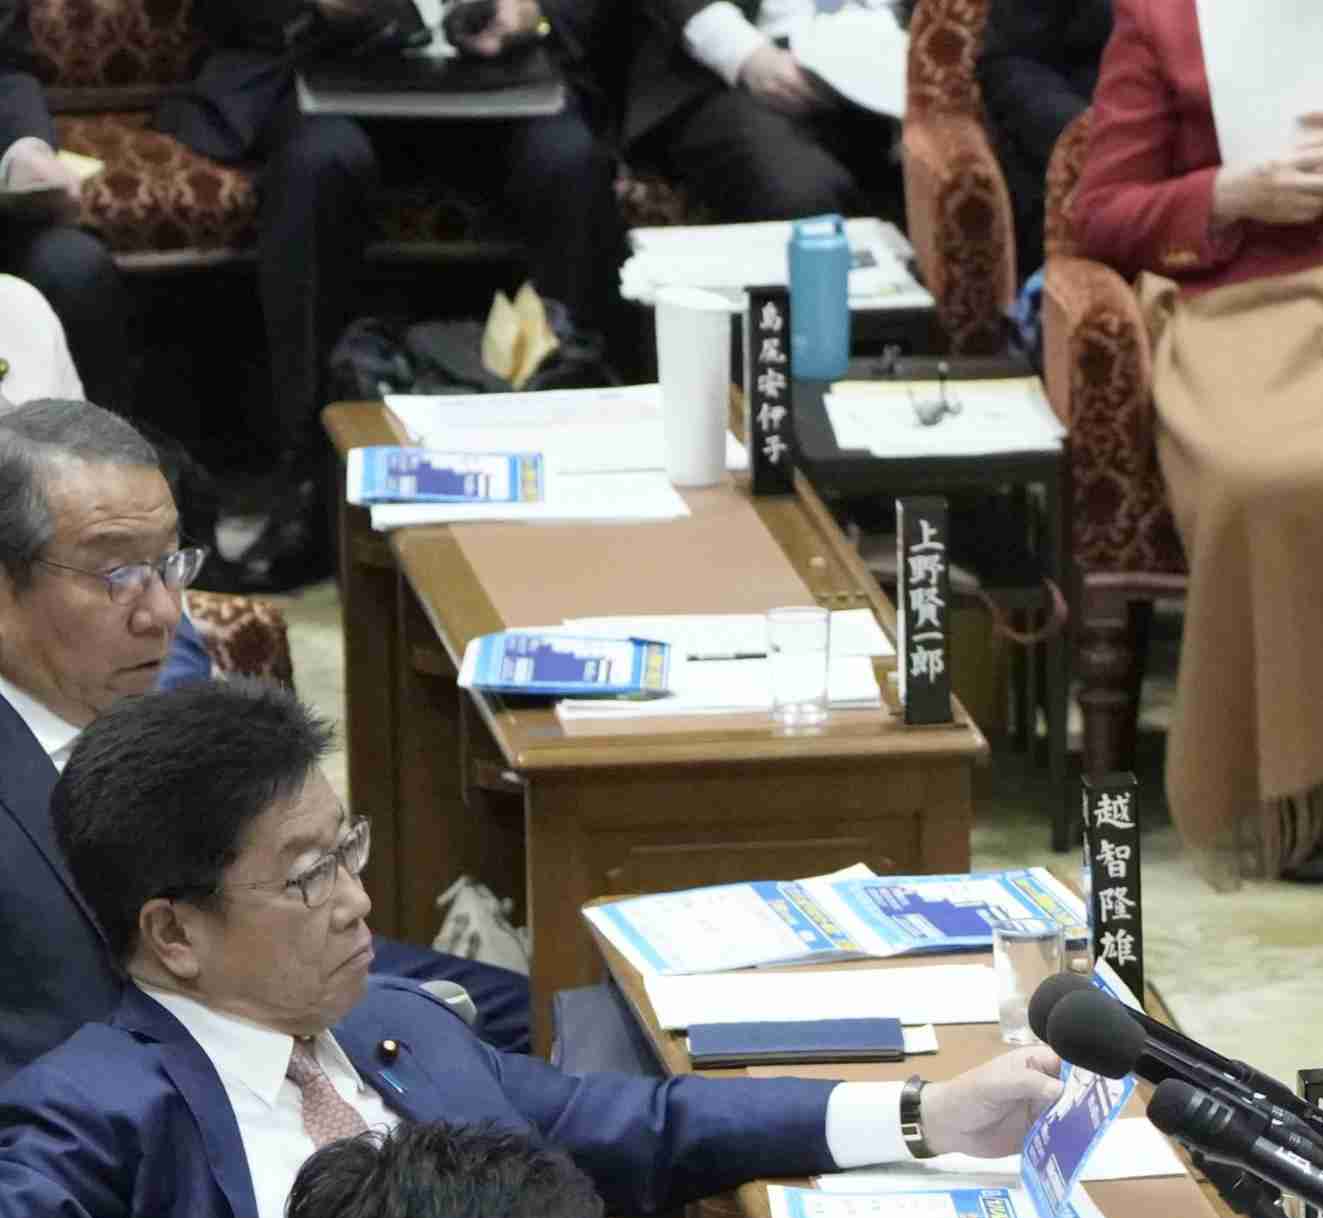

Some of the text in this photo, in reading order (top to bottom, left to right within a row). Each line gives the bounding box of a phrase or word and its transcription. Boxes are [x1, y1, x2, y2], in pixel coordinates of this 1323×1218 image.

[907, 519, 945, 684] 上野賢一郎
[1093, 792, 1137, 966] 越智隆雄
